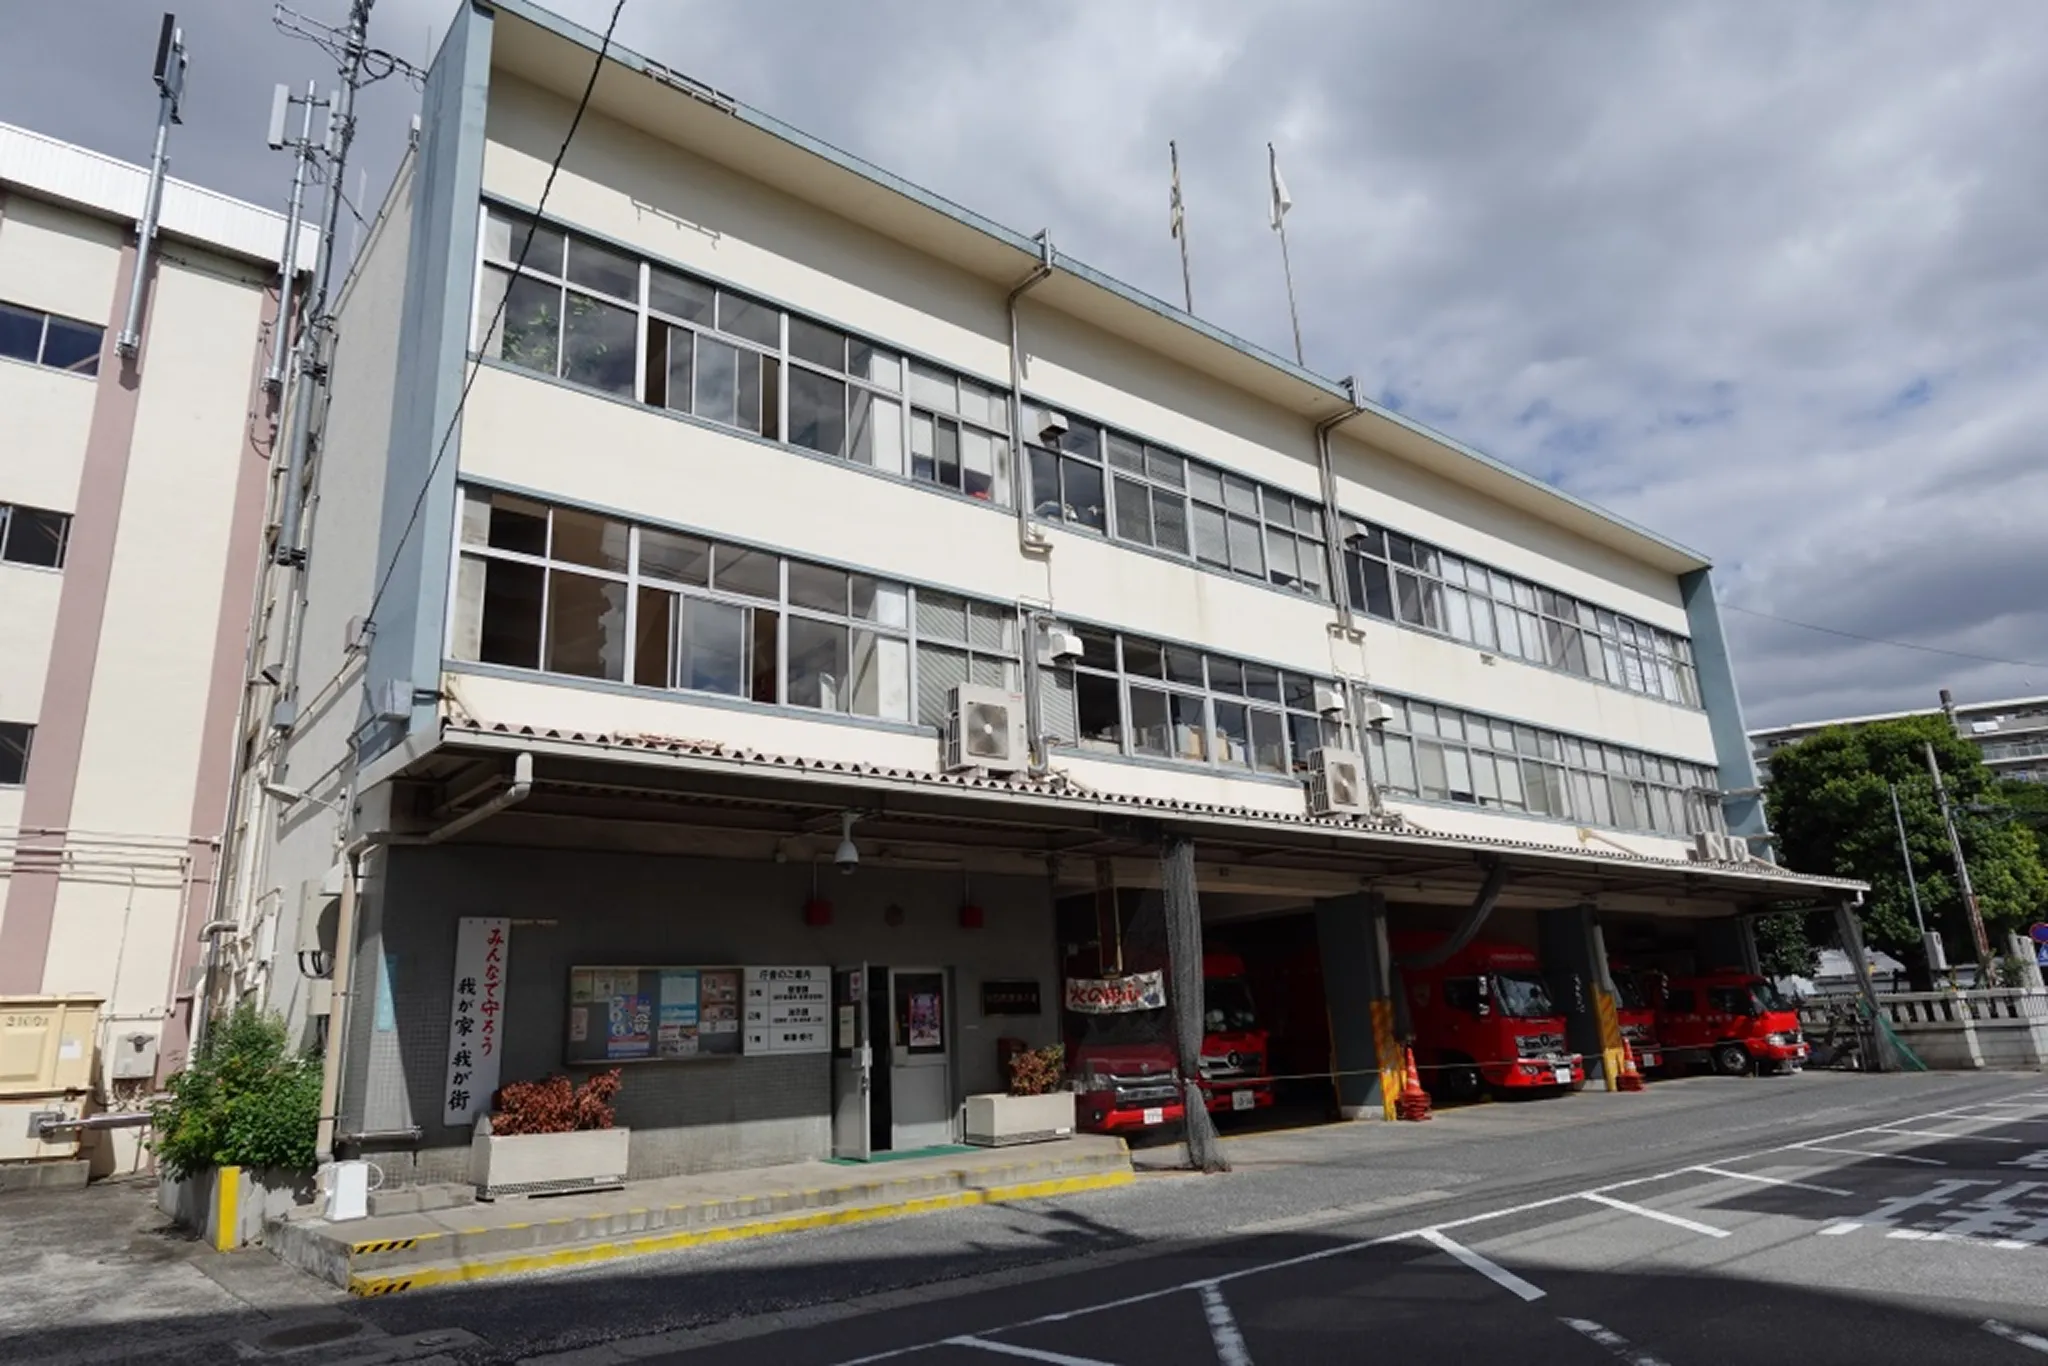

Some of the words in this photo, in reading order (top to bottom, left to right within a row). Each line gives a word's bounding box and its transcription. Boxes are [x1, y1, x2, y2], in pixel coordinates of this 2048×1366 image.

[448, 977, 476, 1111] 我が家・我が街
[481, 928, 504, 1057] みんなで守ろう
